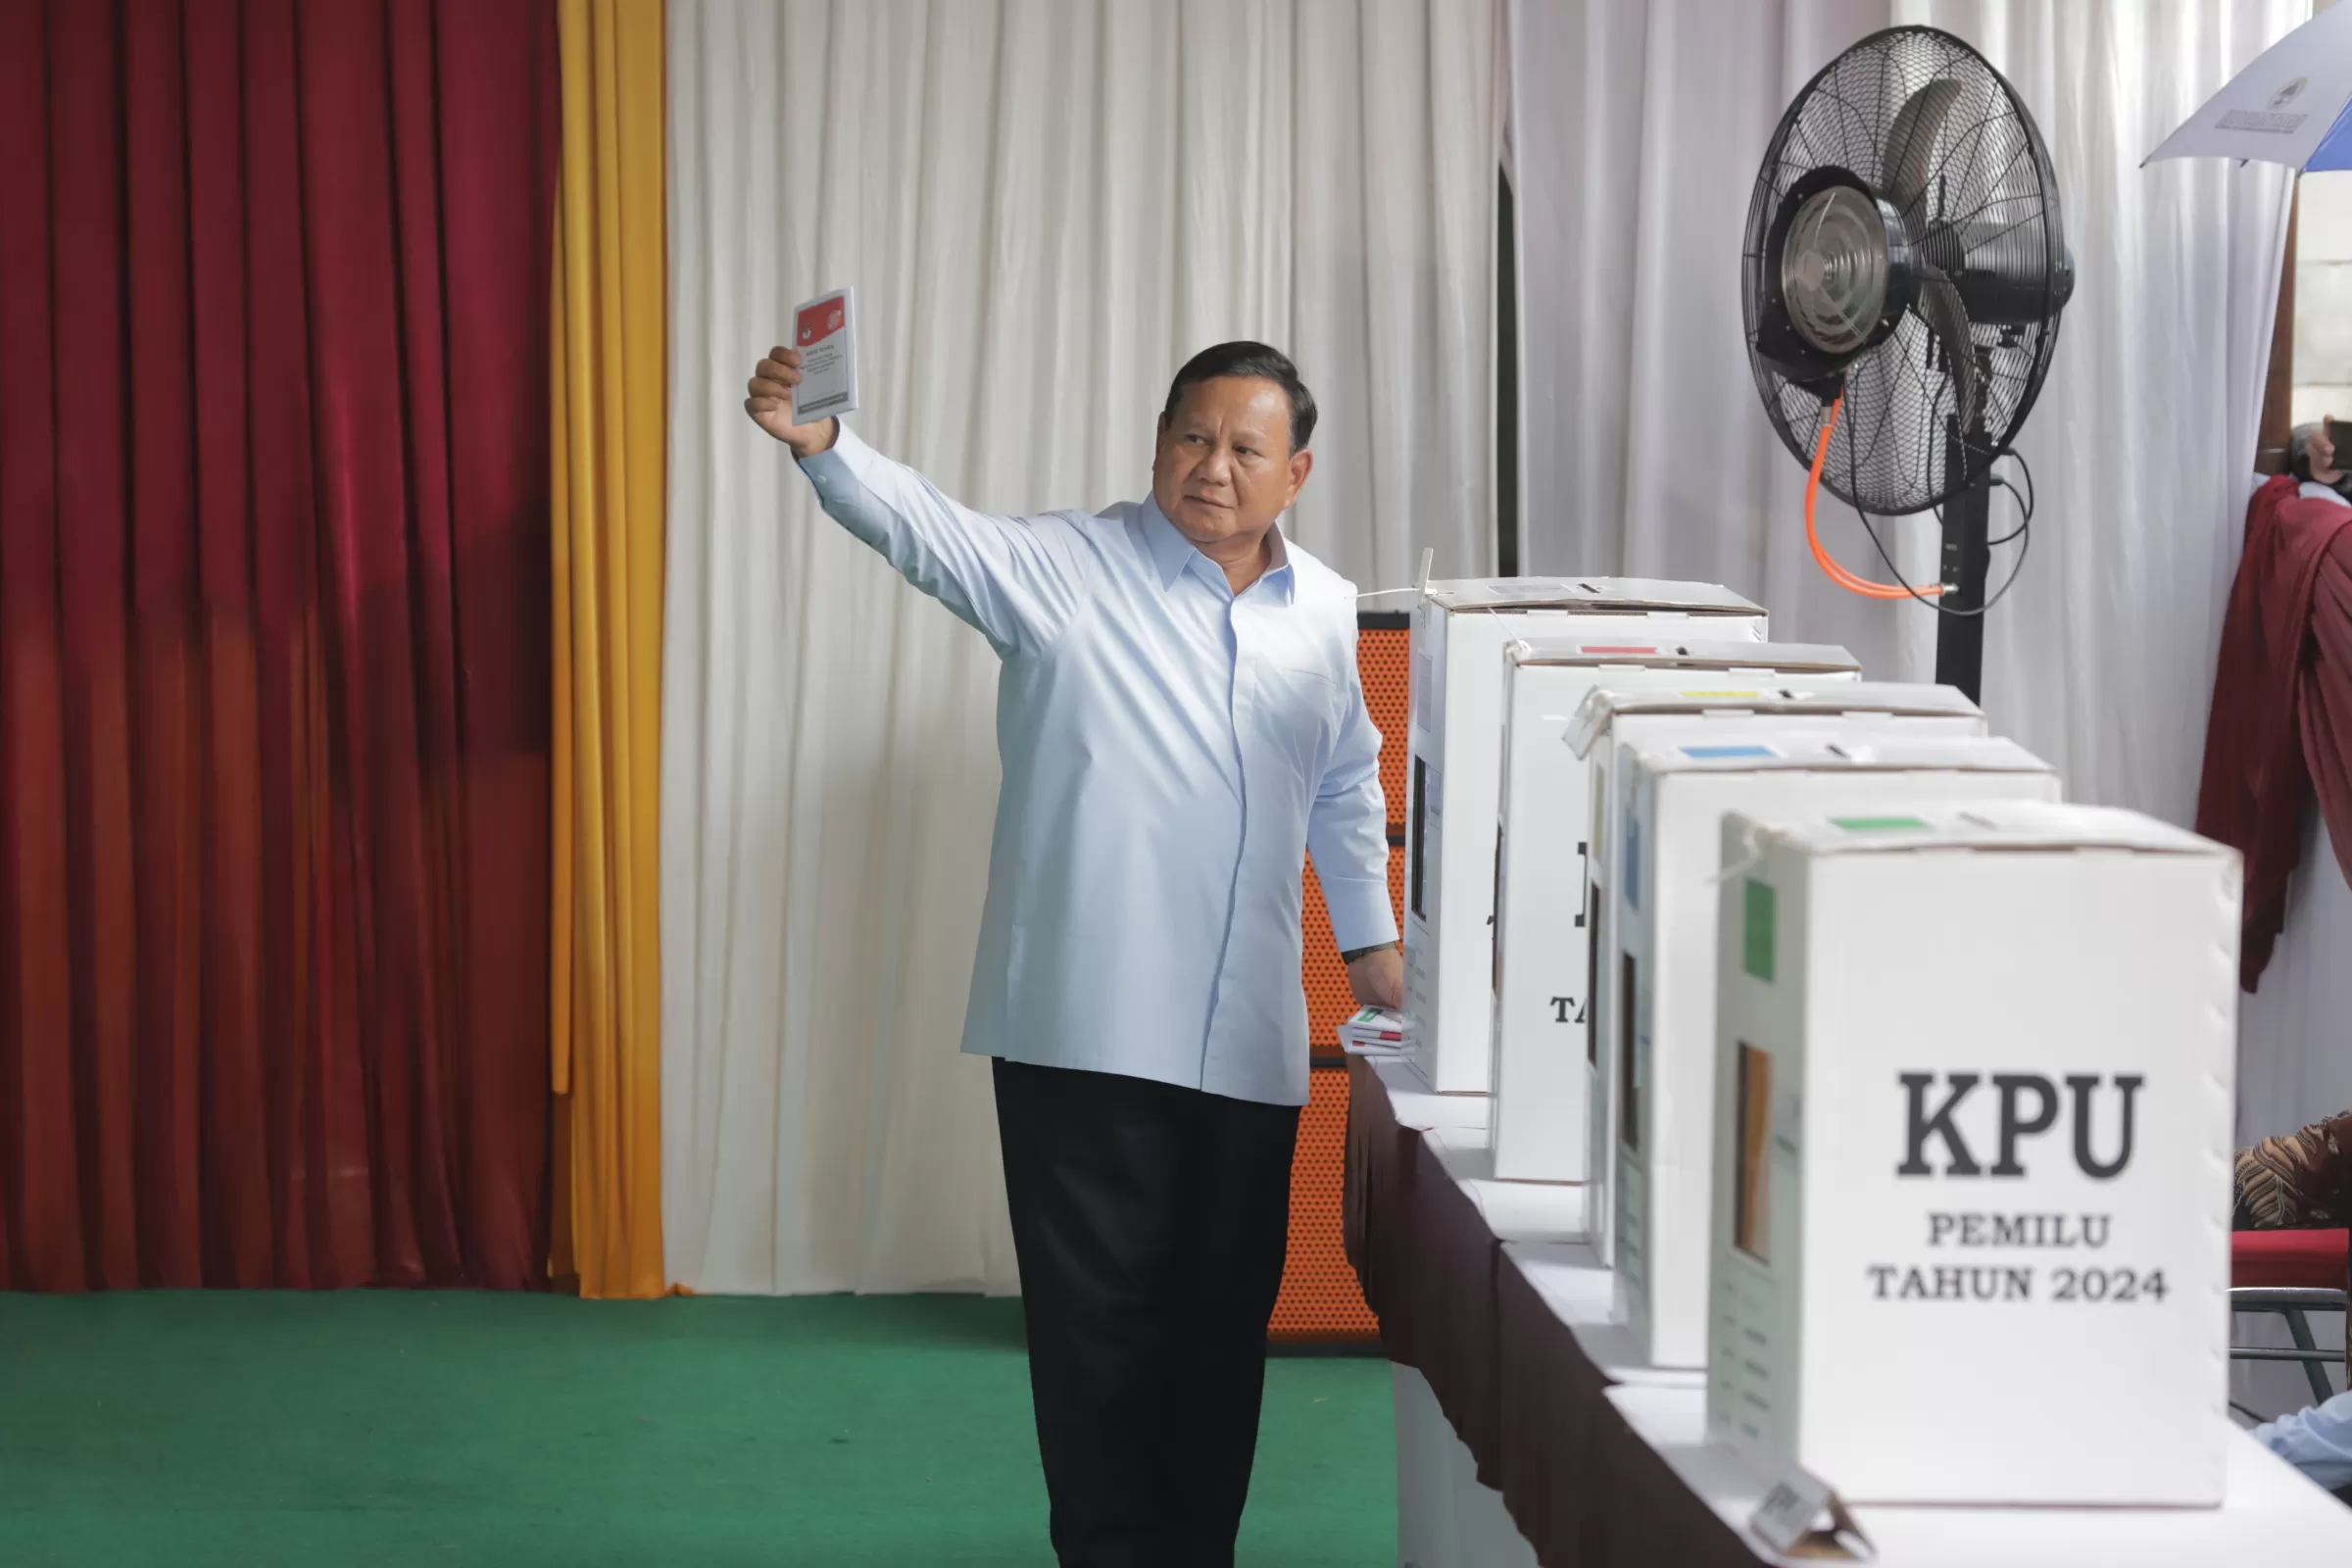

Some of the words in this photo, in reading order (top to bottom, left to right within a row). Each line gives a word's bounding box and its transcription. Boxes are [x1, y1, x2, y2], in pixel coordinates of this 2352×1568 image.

[1897, 1073, 2144, 1180] KPU
[1930, 1213, 2110, 1248] PEMILU
[1869, 1266, 2032, 1299] TAHUN
[2053, 1268, 2168, 1301] 2024
